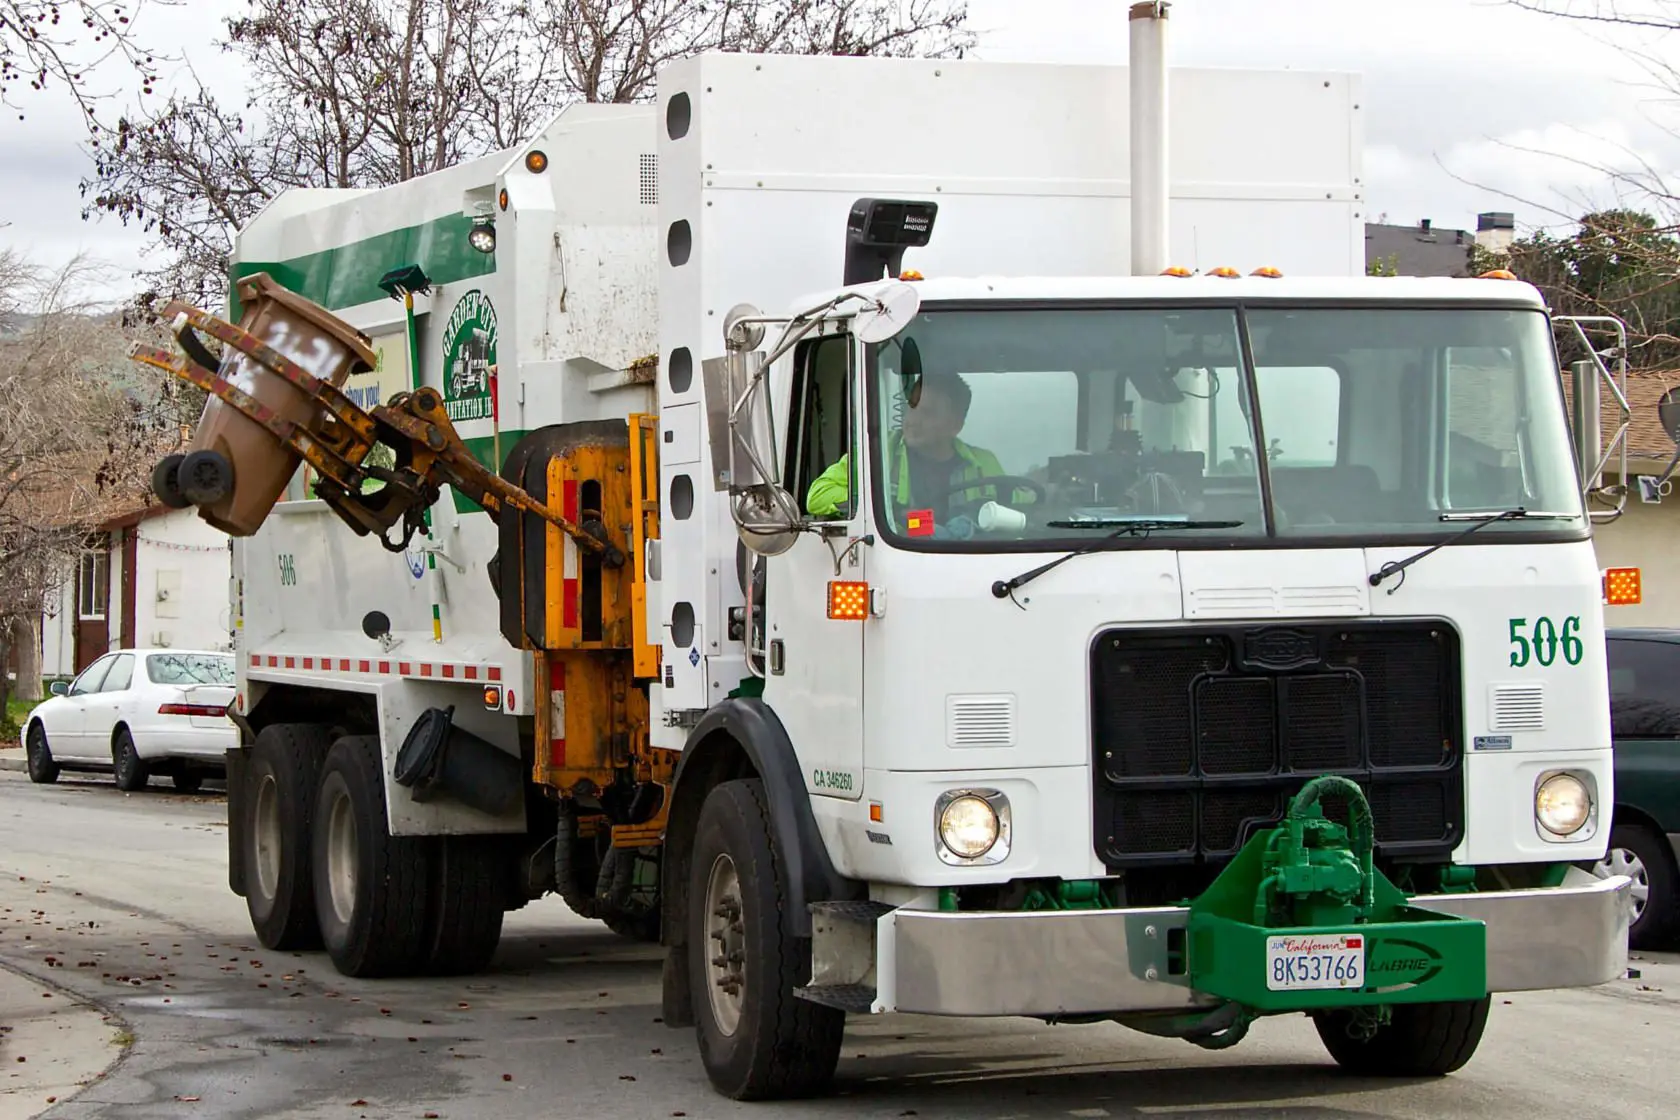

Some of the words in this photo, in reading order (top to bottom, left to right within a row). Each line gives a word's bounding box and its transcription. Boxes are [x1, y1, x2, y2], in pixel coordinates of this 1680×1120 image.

[443, 290, 480, 357] GARDEN
[481, 296, 498, 351] CITY
[365, 381, 380, 409] you!
[278, 554, 297, 586] 506
[1509, 616, 1583, 667] 506
[813, 769, 826, 787] CA
[827, 771, 853, 791] 346260
[1286, 939, 1345, 955] California
[1273, 955, 1358, 982] 8K53766
[1370, 958, 1430, 973] LABRIE
